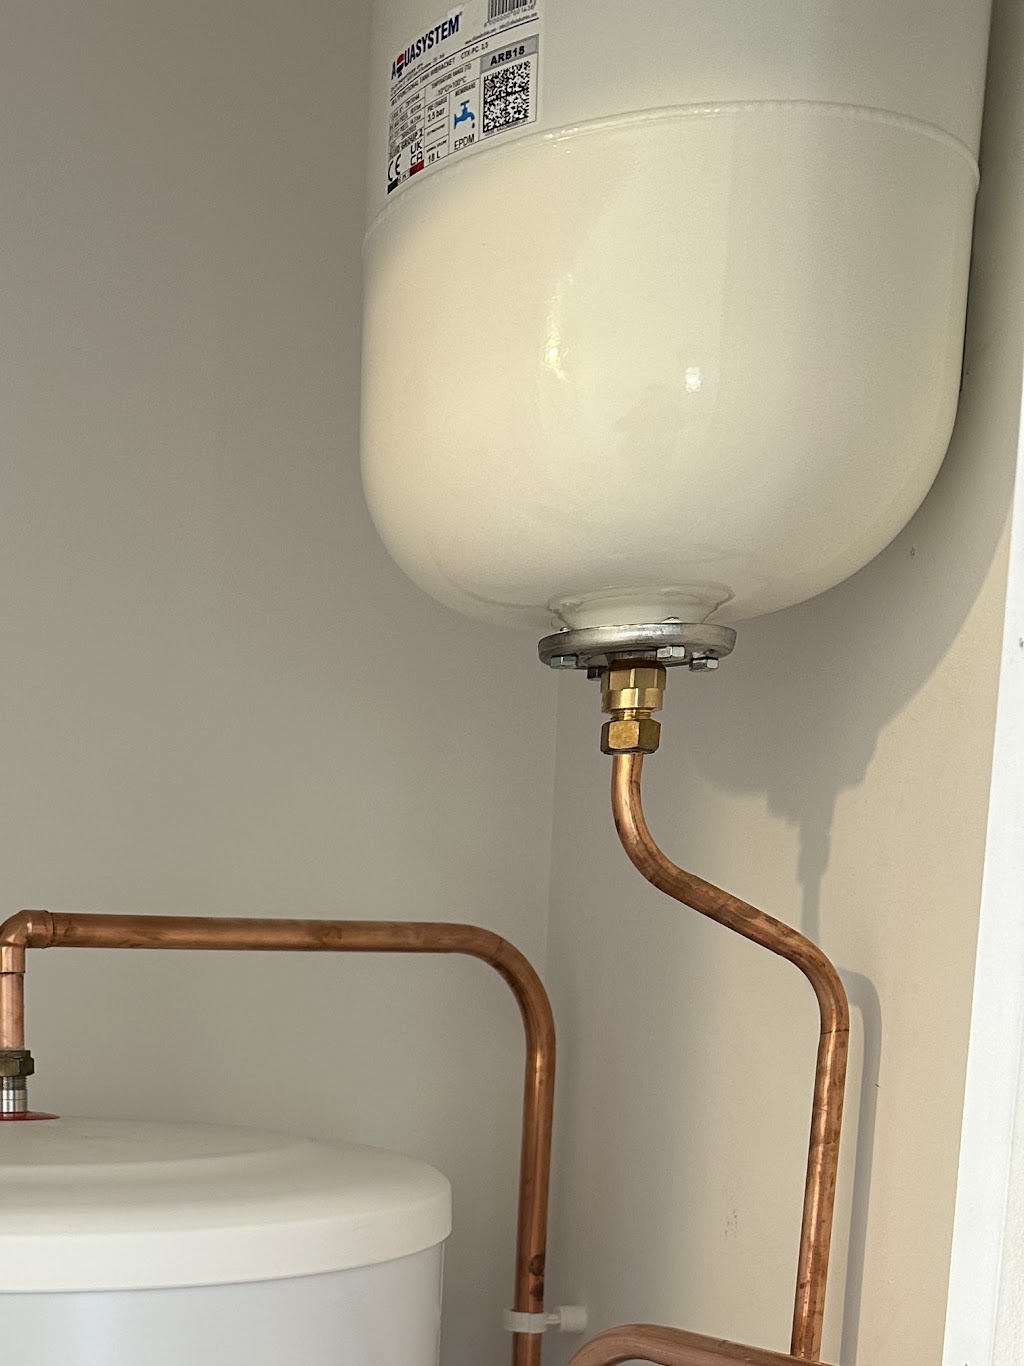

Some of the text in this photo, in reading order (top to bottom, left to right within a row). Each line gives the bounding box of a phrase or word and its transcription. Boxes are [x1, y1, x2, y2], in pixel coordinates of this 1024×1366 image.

[391, 14, 460, 80] AQUASYSTEM
[490, 45, 525, 66] ARB18
[454, 134, 474, 150] EPDM
